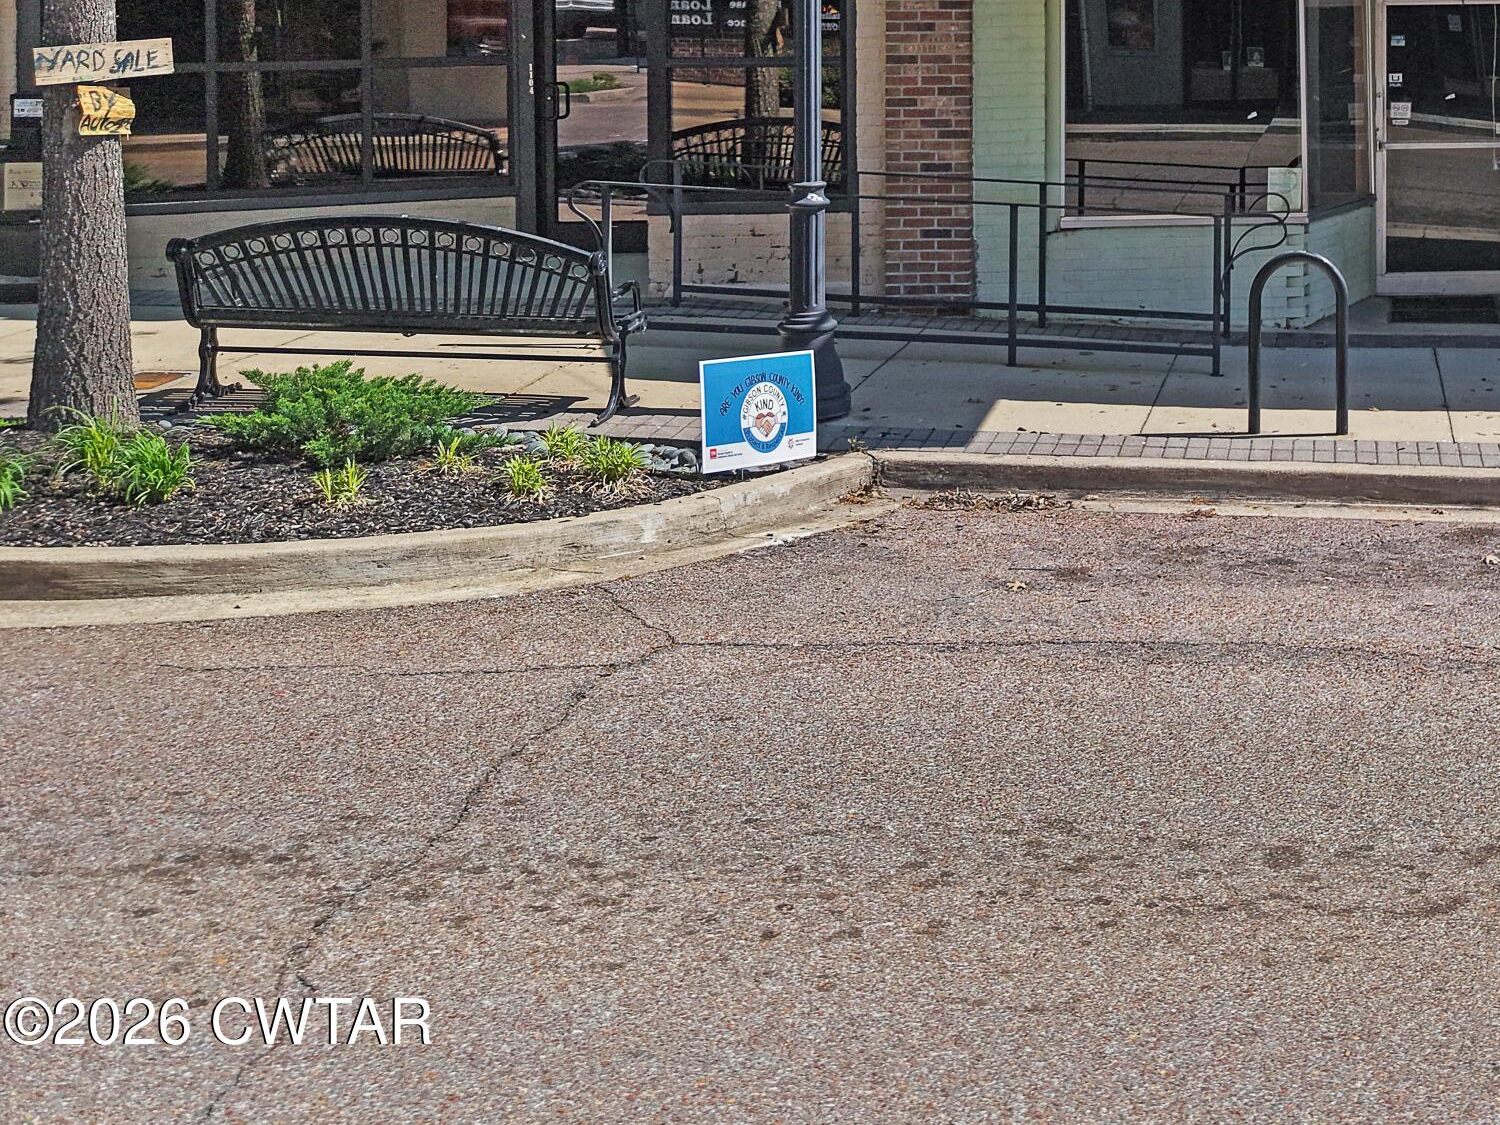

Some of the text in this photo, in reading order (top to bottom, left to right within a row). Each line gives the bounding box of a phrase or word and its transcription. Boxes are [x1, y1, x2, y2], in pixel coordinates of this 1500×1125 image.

[109, 48, 164, 74] SALE
[720, 372, 805, 417] ARE YOU GIBSON COUNTY KIND?
[743, 384, 786, 420] #GIBSON COUNTY
[755, 398, 774, 412] KIND
